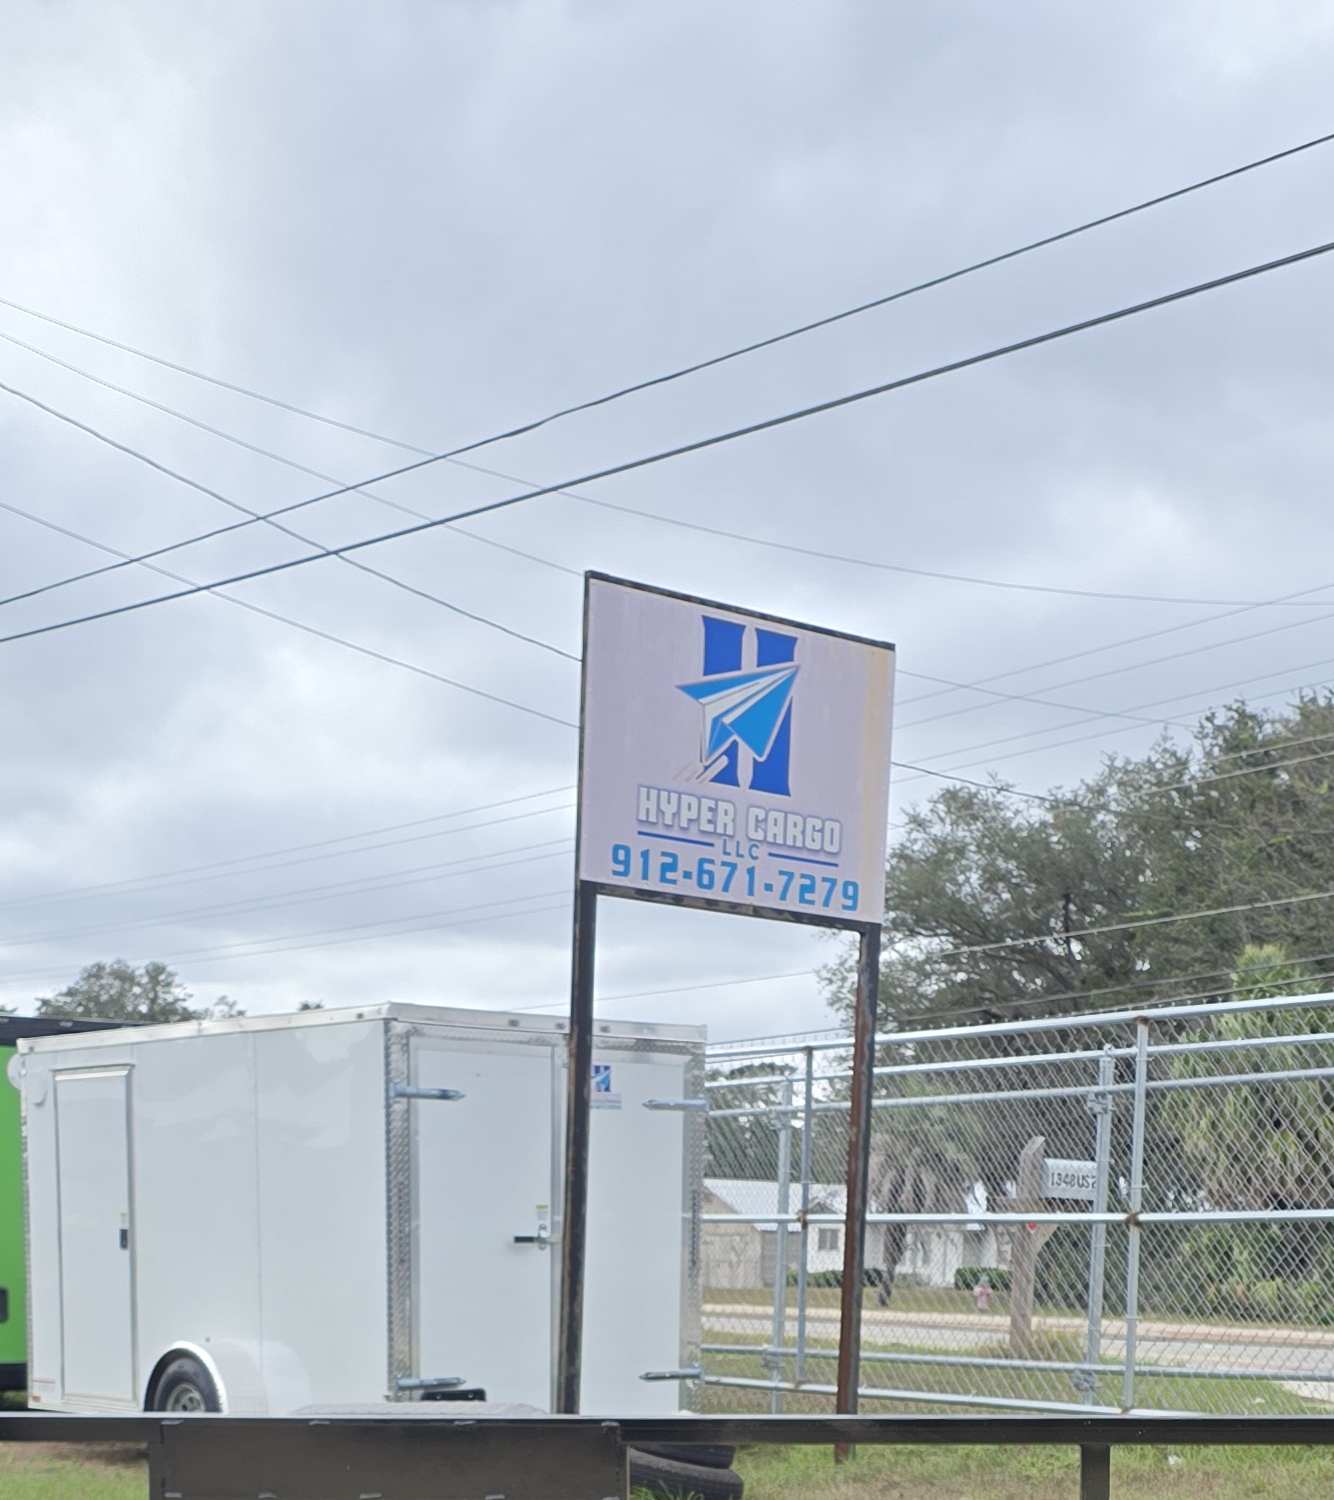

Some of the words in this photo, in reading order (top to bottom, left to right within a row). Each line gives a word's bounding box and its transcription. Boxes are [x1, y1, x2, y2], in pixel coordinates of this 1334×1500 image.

[637, 785, 736, 837] HYPER
[747, 806, 842, 854] CARGO
[722, 838, 760, 861] LLC
[611, 843, 859, 912] 912-671-7279
